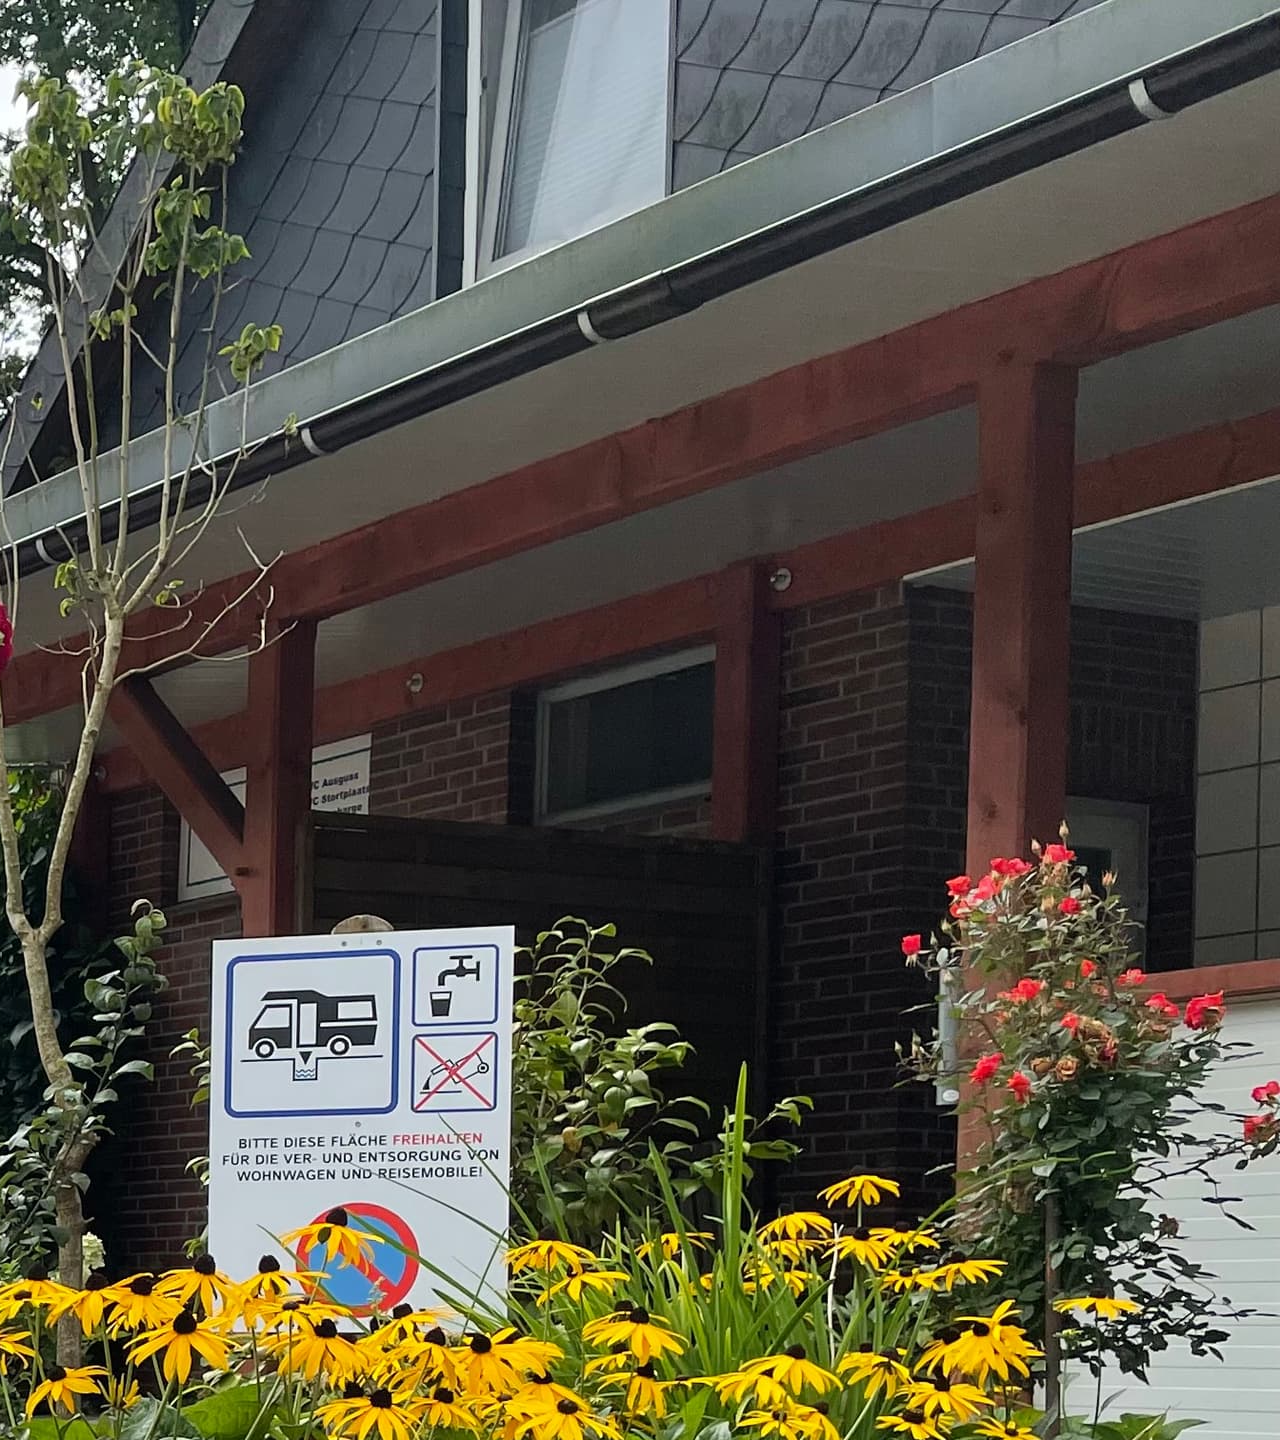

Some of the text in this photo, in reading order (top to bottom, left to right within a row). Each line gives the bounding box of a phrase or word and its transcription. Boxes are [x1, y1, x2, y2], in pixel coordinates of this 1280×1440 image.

[238, 1132, 483, 1149] BITTE DIESE FLÄCHE FREIHALTEN
[222, 1149, 500, 1166] FÜR DIE VER- UND ENTSORGUNG VON
[236, 1166, 483, 1182] WOHNWAGEN UND REISEMOBILE!
